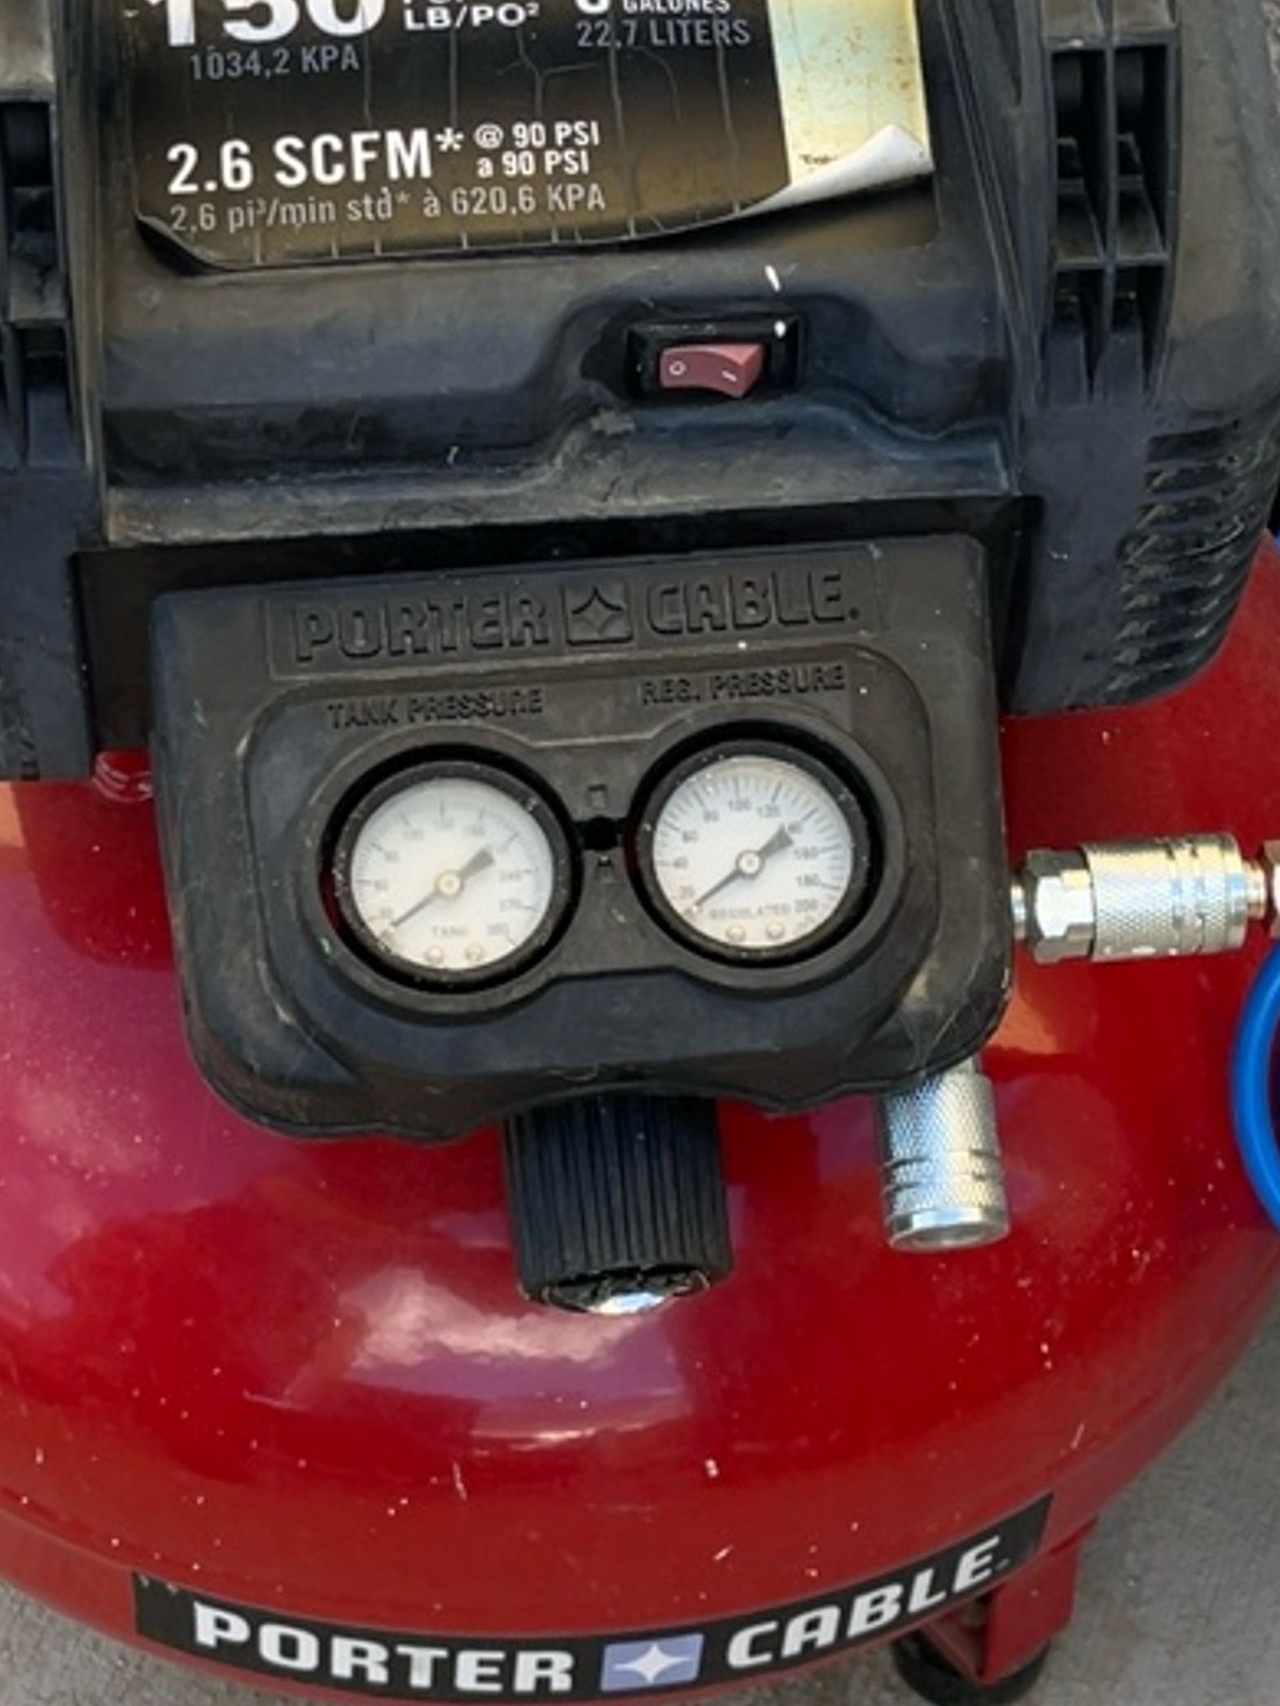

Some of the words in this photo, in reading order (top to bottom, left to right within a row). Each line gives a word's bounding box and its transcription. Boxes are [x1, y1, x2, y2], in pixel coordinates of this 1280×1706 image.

[650, 18, 751, 46] LITERS
[190, 49, 291, 80] 1034,2
[301, 44, 360, 73] KPA
[474, 123, 505, 150] @
[512, 122, 547, 148] 90
[555, 120, 600, 146] PSI
[166, 139, 255, 194] 2.6
[476, 156, 494, 178] a
[502, 151, 536, 177] 90
[544, 150, 590, 175] PSI
[423, 186, 441, 217] à
[547, 182, 607, 212] KPA
[294, 589, 550, 663] PORTER
[711, 664, 848, 699] PRESSURE
[326, 698, 399, 730] TANK
[406, 690, 545, 724] PRESSURE
[192, 1599, 576, 1694] PORTER
[726, 1535, 1003, 1670] CABLE
